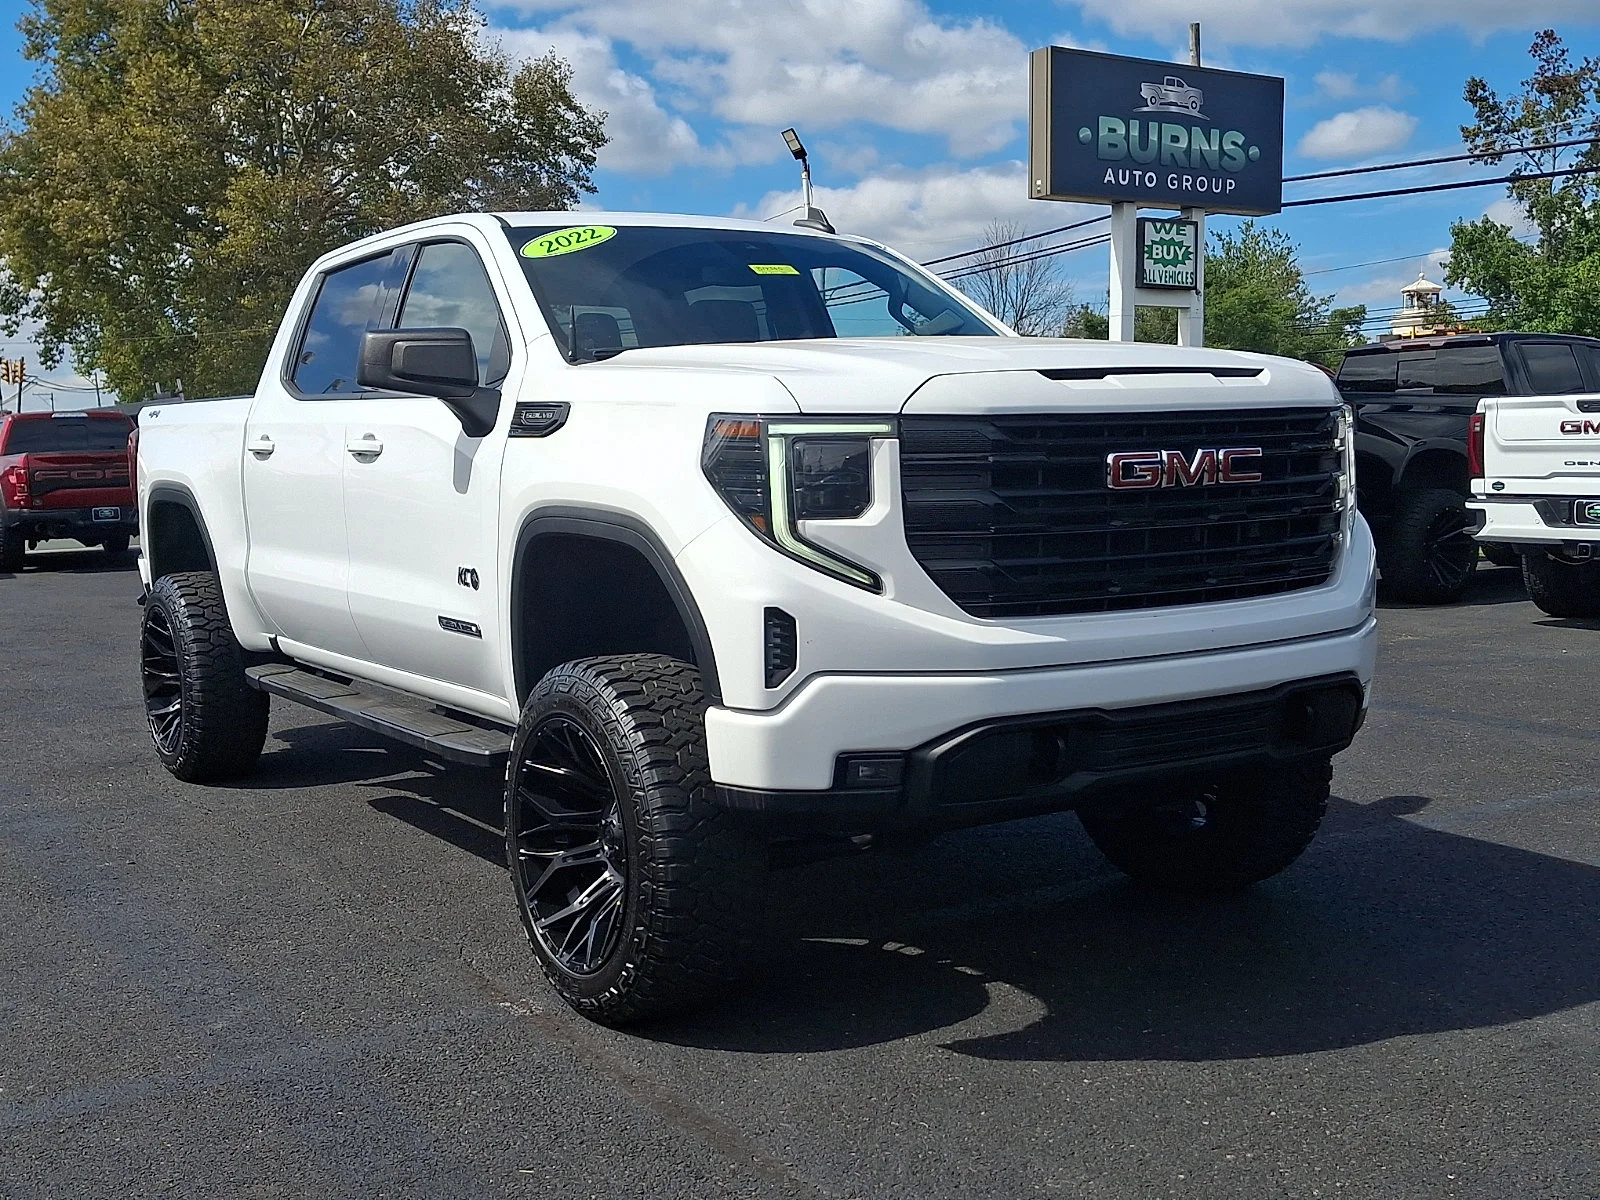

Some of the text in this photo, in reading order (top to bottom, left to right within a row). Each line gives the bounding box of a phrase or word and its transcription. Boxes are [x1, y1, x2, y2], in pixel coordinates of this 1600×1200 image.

[1097, 115, 1246, 173] BURNS
[1104, 167, 1236, 194] AUTO GROUP
[539, 228, 602, 253] 2022
[1151, 221, 1187, 236] WE
[1152, 244, 1187, 260] BUY
[1158, 270, 1194, 285] VEHICLES
[1106, 447, 1263, 489] GMC
